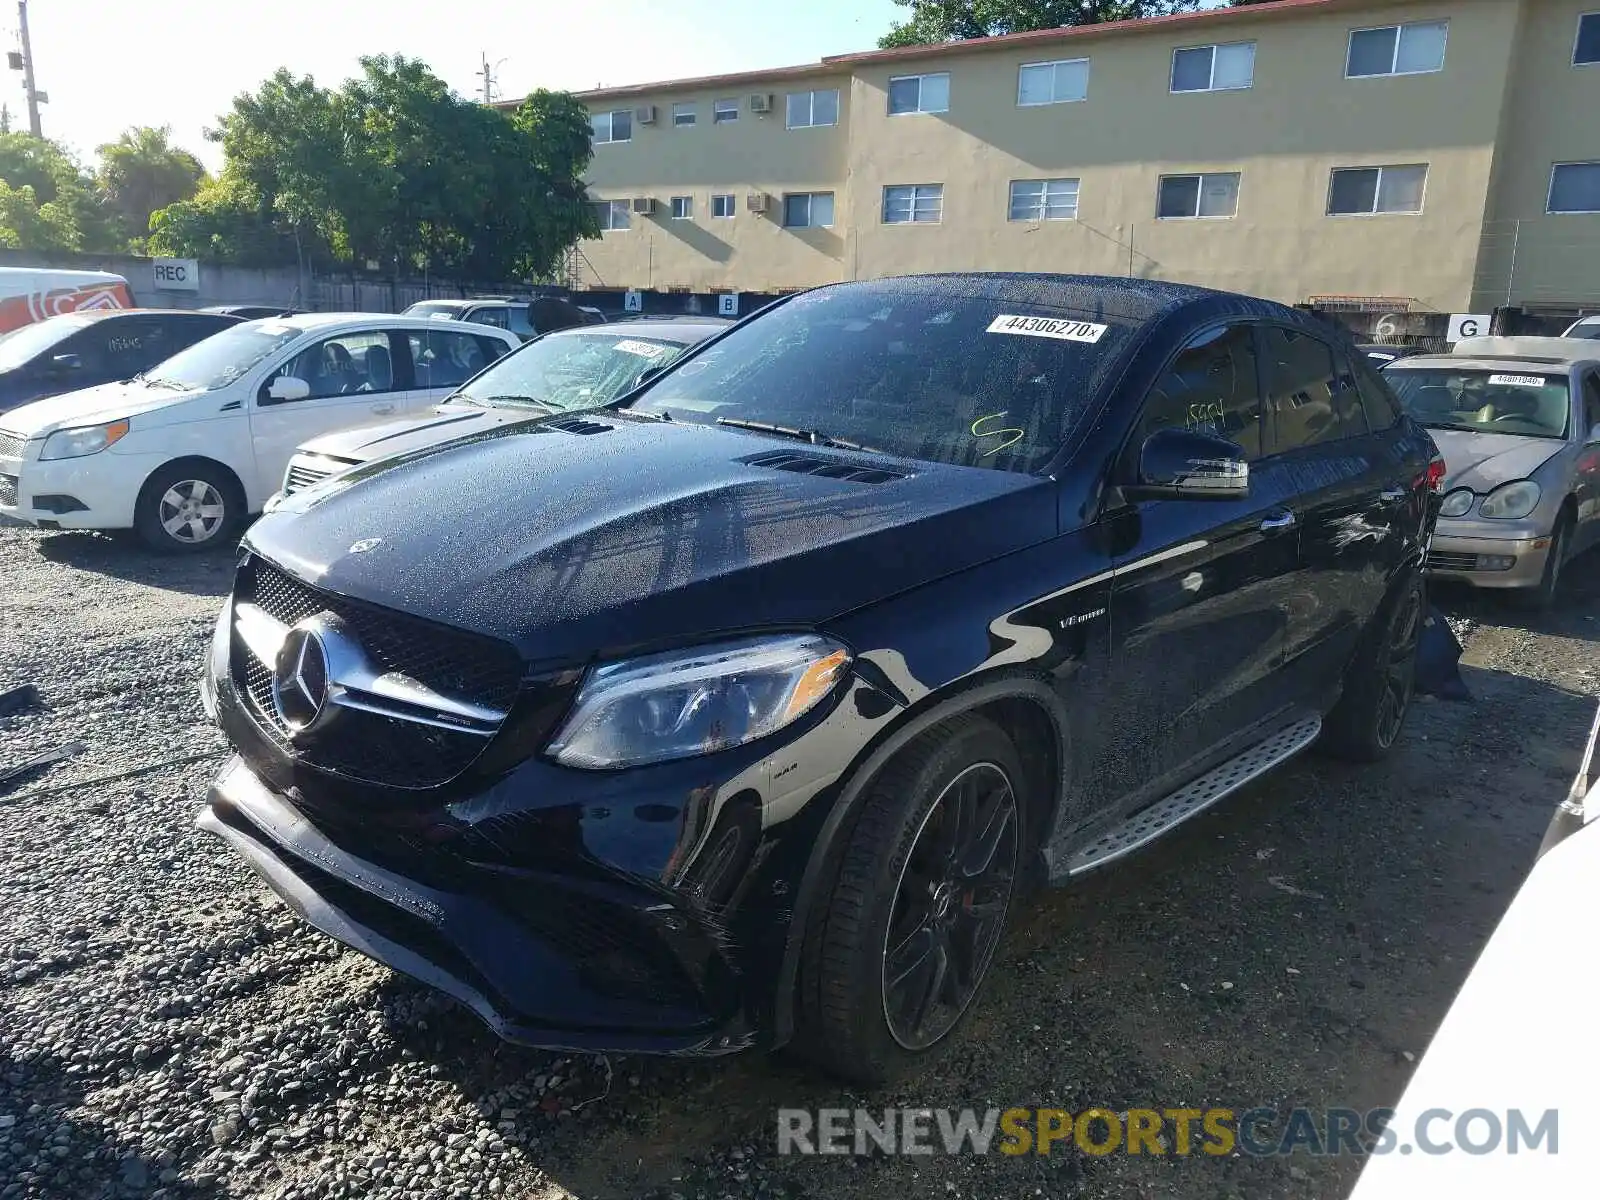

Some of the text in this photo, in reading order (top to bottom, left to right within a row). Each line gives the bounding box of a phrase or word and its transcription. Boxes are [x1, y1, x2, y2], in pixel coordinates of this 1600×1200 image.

[155, 265, 186, 281] REC
[629, 295, 637, 307] A
[725, 298, 733, 311] B
[1459, 319, 1478, 337] G
